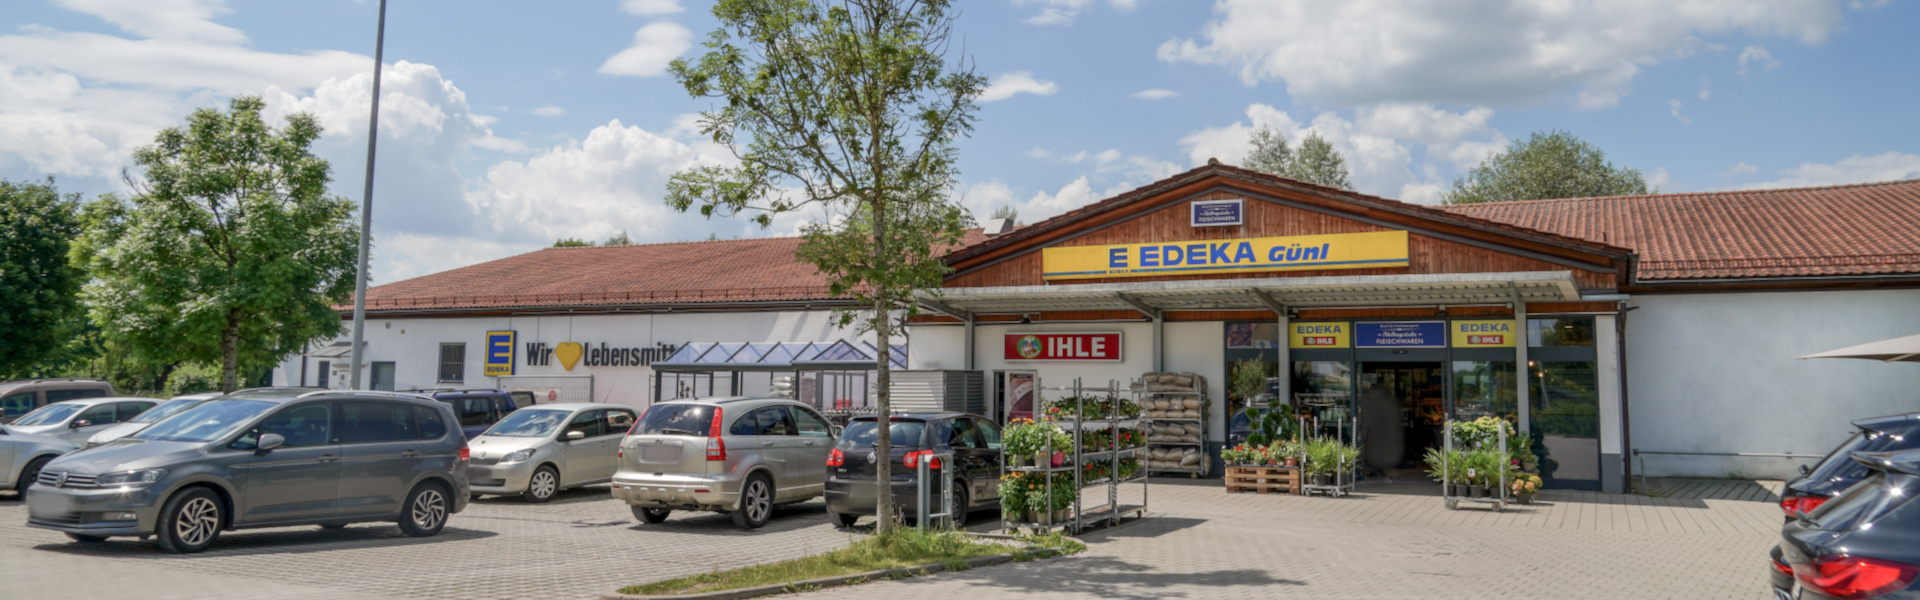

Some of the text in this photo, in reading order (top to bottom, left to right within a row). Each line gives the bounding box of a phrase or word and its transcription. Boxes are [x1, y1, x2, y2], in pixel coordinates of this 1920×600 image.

[1109, 241, 1330, 268] E EDEKA Günl
[1297, 325, 1342, 334] EDEKA
[1460, 323, 1509, 332] EDEKA
[488, 335, 510, 364] E
[526, 342, 553, 366] Wir
[1048, 336, 1106, 357] IHLE
